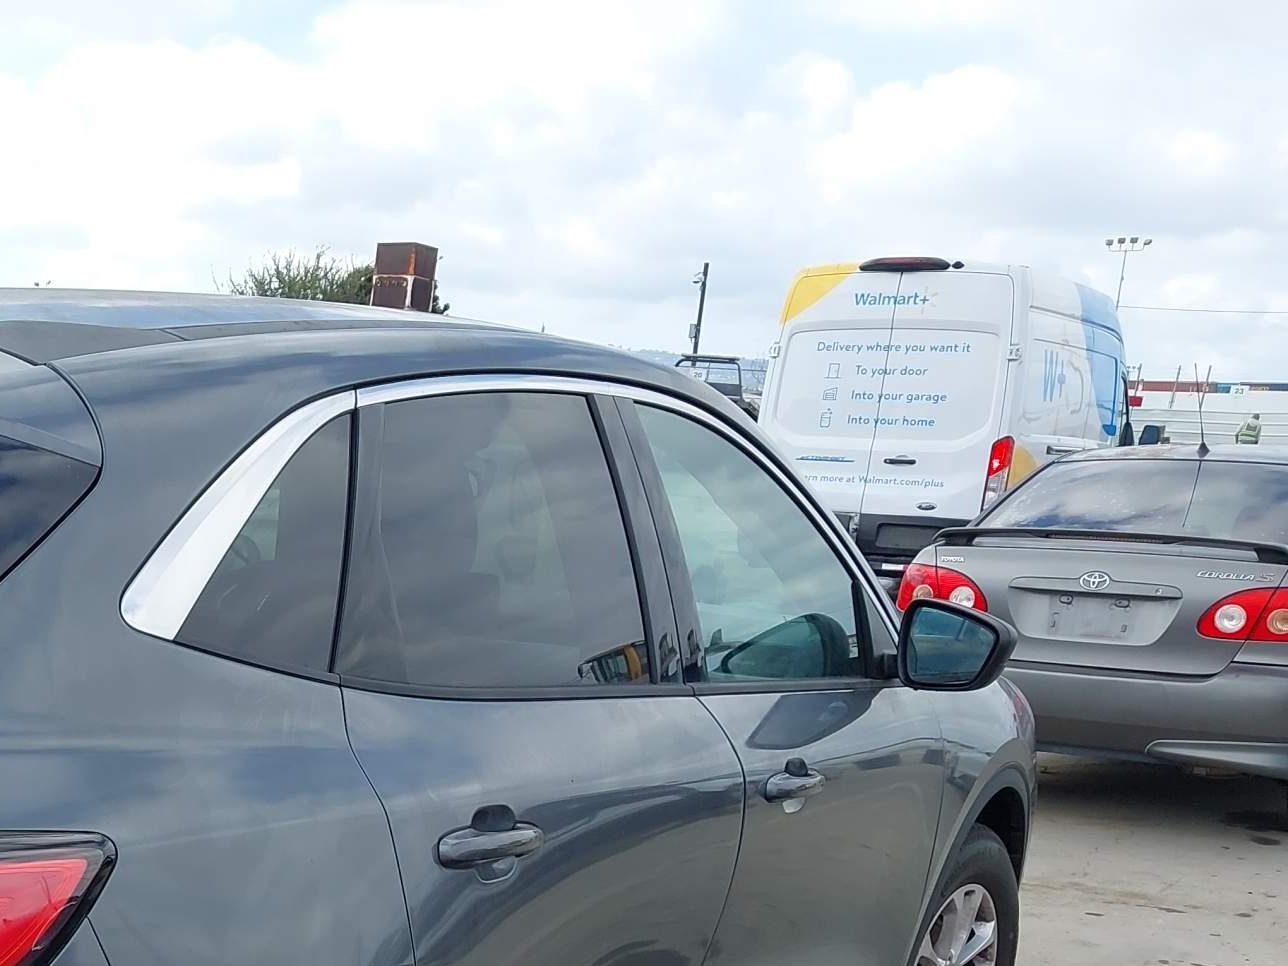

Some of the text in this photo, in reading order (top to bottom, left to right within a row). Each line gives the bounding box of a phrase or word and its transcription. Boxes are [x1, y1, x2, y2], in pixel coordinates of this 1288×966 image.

[854, 292, 930, 306] Walmart+
[816, 341, 971, 355] Delivery where you want it
[855, 364, 928, 378] To your door
[850, 389, 948, 405] Into your garage
[847, 414, 935, 429] Into your home
[819, 475, 844, 483] more
[845, 475, 855, 483] at
[857, 475, 944, 488] Walmart.com/plus
[1196, 570, 1256, 581] COROLLA
